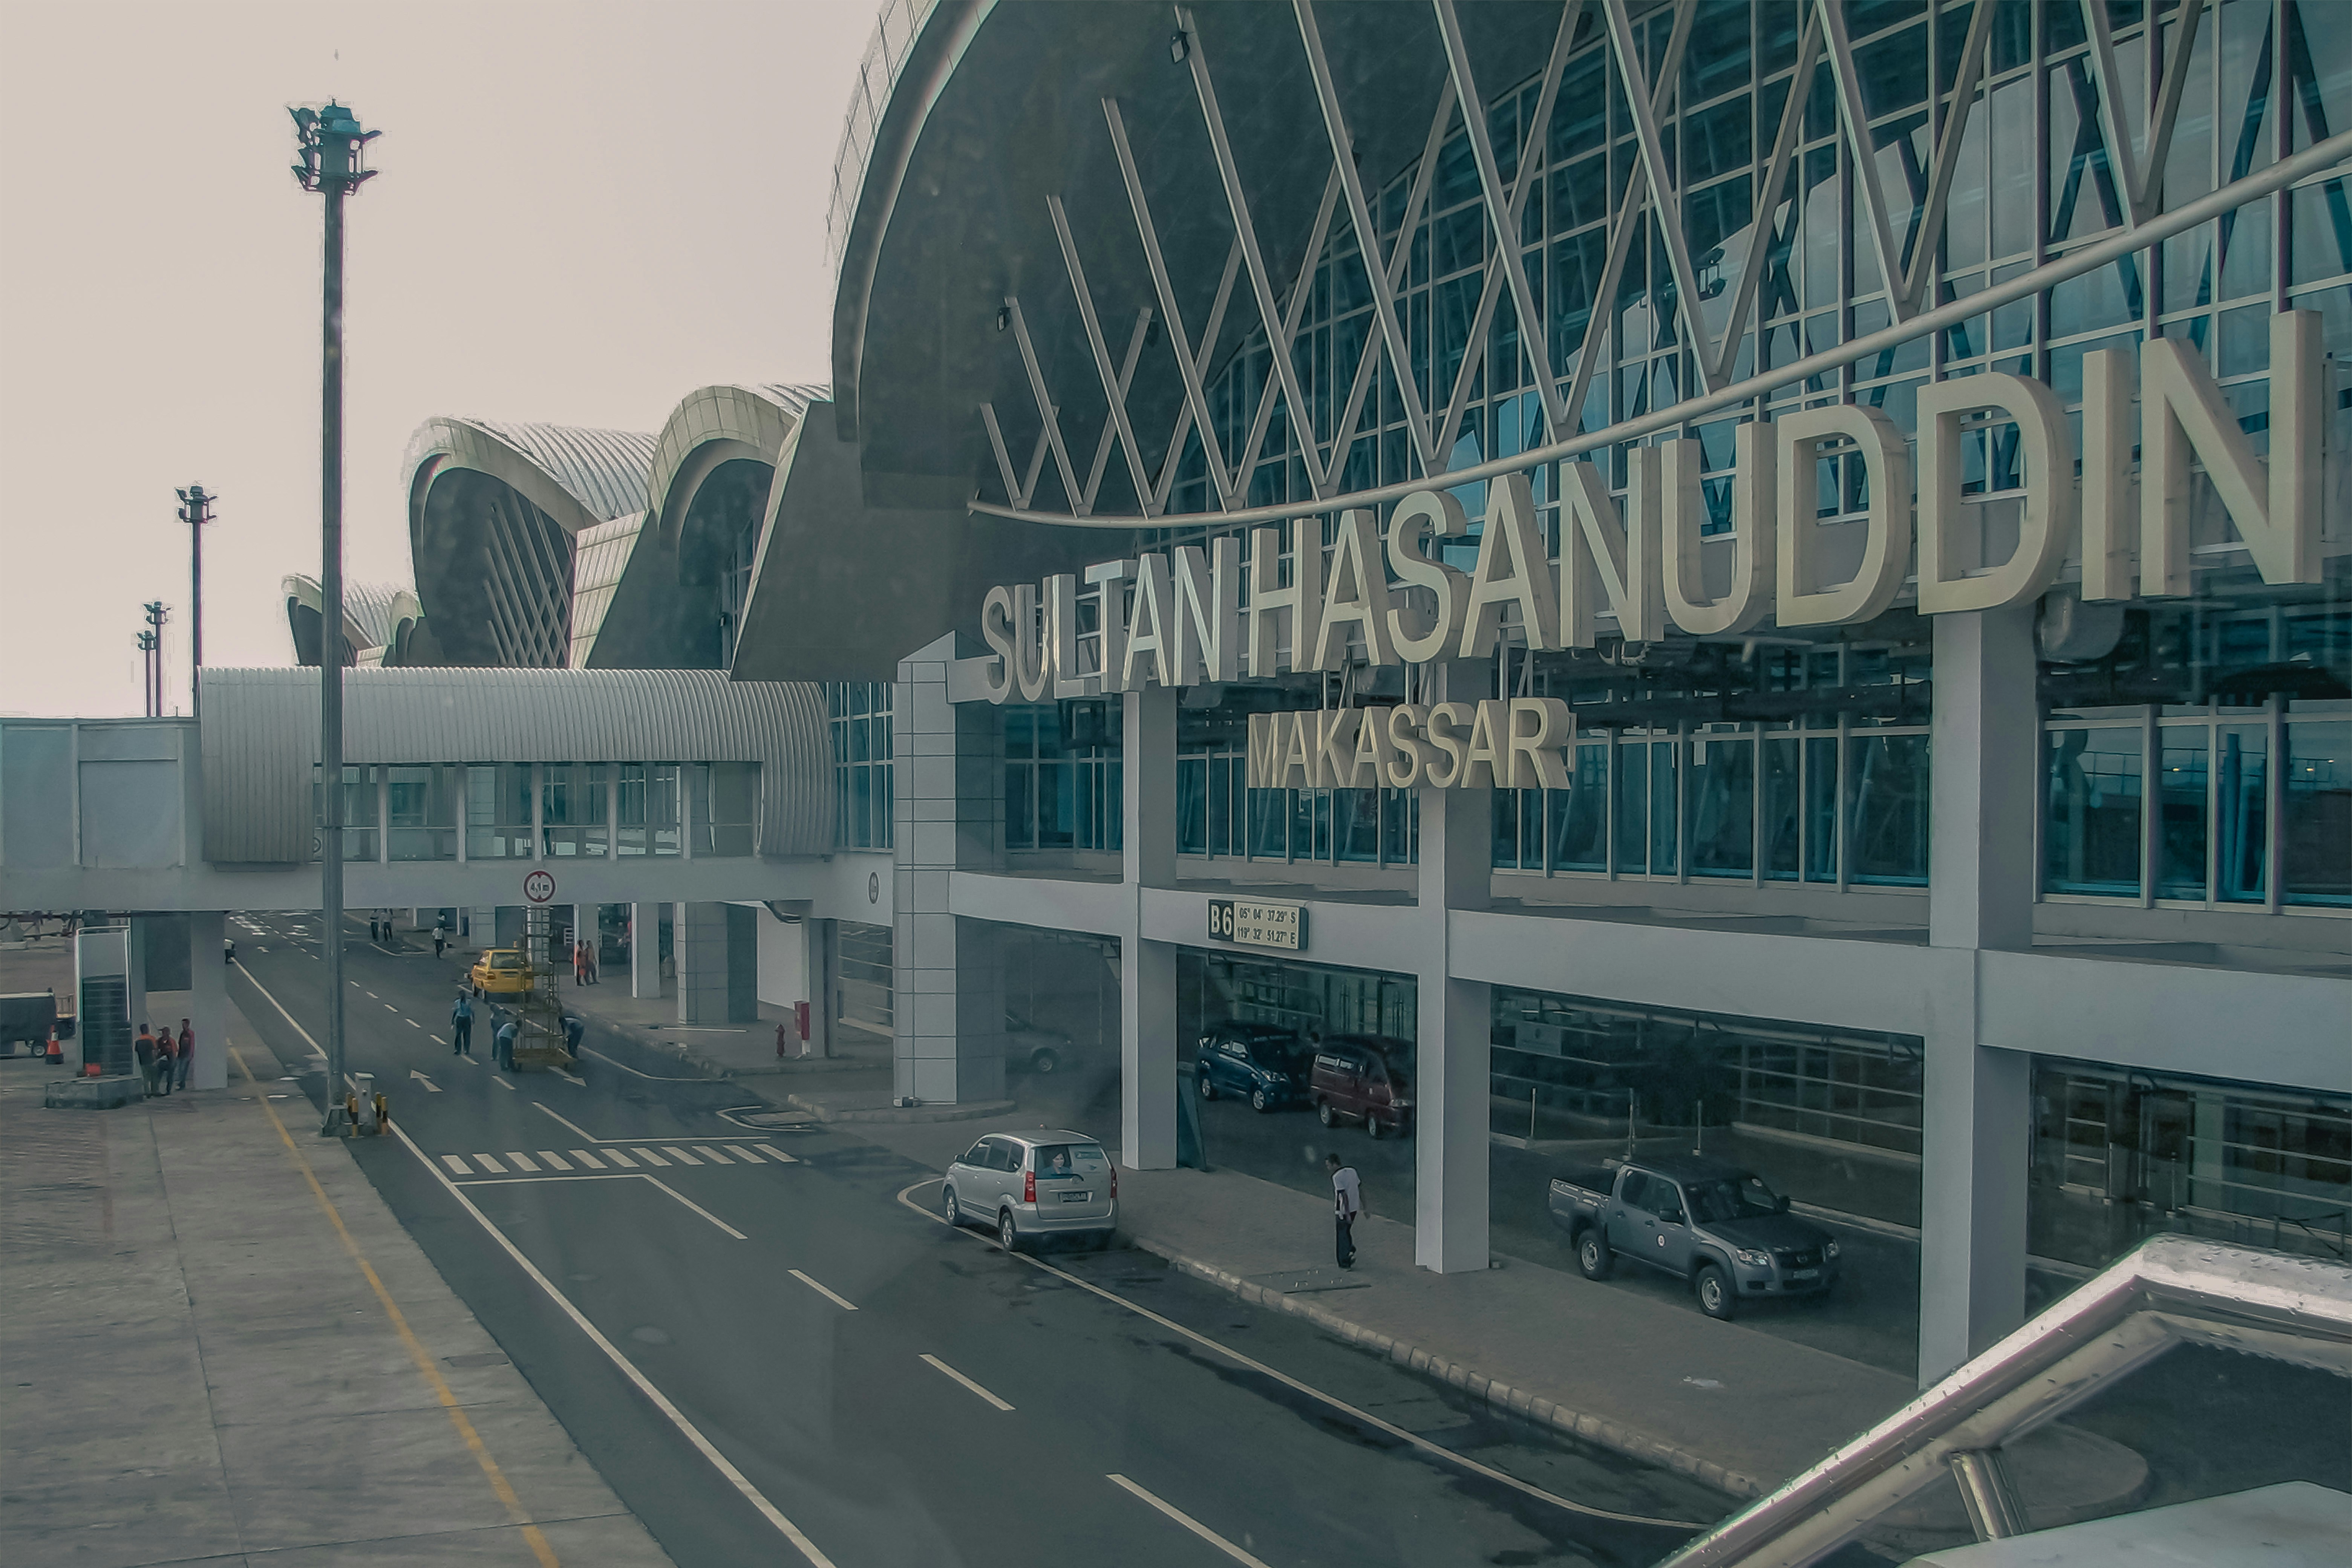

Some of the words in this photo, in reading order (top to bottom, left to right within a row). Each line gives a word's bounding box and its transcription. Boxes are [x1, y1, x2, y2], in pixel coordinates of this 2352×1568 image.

[982, 537, 1240, 705] SULTAN
[1248, 310, 2323, 678] HASANUDDIN
[1248, 698, 1571, 790] MAKASSAR
[1211, 904, 1232, 936] B6
[1290, 911, 1296, 924] S
[1290, 932, 1295, 945] E
